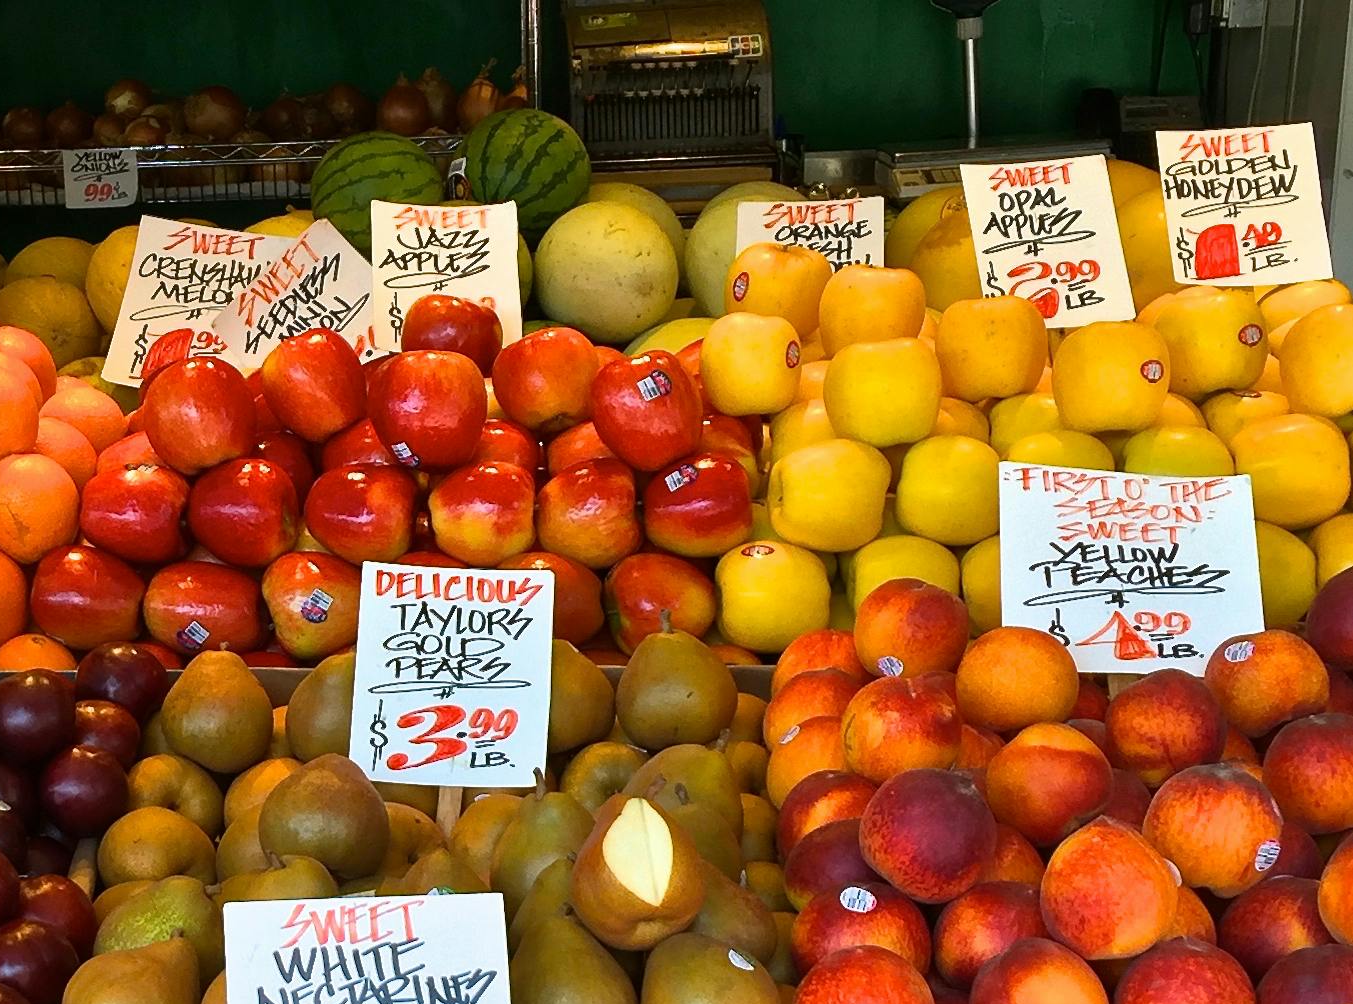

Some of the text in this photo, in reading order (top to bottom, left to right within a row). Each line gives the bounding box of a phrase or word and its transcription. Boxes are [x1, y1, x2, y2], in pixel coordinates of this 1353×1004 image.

[1179, 130, 1274, 161] SWEET
[1165, 149, 1291, 176] GOLDEN
[989, 162, 1073, 191] SWEET
[1164, 165, 1298, 203] HONEYDEW
[763, 200, 862, 228] SWEET
[999, 187, 1066, 214] OPAL
[392, 207, 491, 229] SWEET
[774, 220, 872, 241] ORANGE
[983, 208, 1082, 239] APPLES
[163, 227, 264, 259] SWEET
[397, 225, 489, 250] JAZZ
[379, 249, 490, 273] APPLES
[151, 281, 234, 304] MELO
[238, 233, 321, 327] SWEET
[1160, 479, 1232, 504] THE
[1057, 522, 1187, 544] SWEET
[1049, 541, 1179, 565] YELLOW
[1029, 560, 1230, 588] PEACHES
[375, 570, 544, 606] DELICIOUS
[391, 601, 533, 640] TAYLORS
[383, 632, 505, 658] GOLD
[1158, 643, 1204, 658] LB.
[386, 656, 511, 681] PEARS
[470, 751, 515, 768] LB.
[280, 901, 424, 948] SWEET
[273, 937, 425, 992] WHITE
